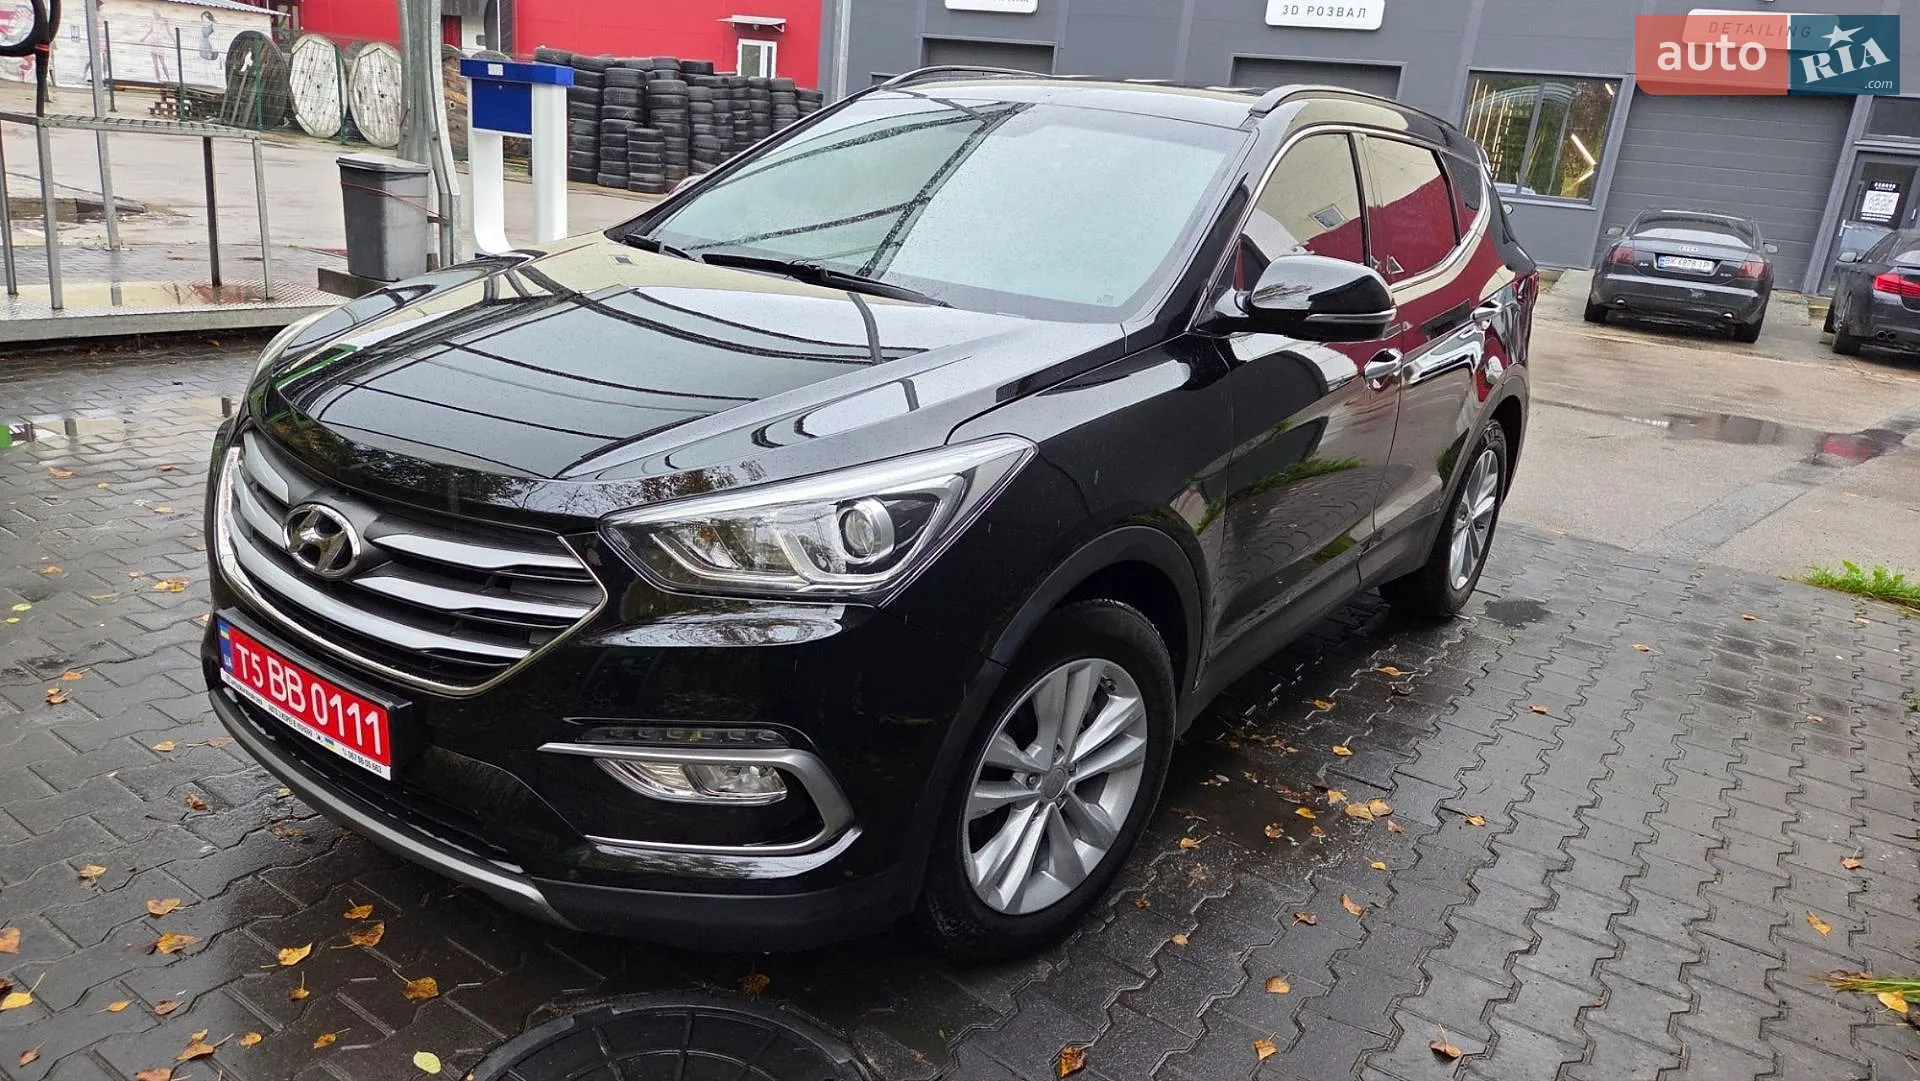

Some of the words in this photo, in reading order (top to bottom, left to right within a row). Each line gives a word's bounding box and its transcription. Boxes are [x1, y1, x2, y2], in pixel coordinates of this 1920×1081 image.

[1282, 5, 1299, 16] 3D
[1306, 6, 1367, 18] РОЗВАЛ
[1708, 21, 1812, 39] DETAILING
[235, 642, 264, 688] T5
[266, 655, 306, 713] BB
[310, 682, 382, 756] 0111
